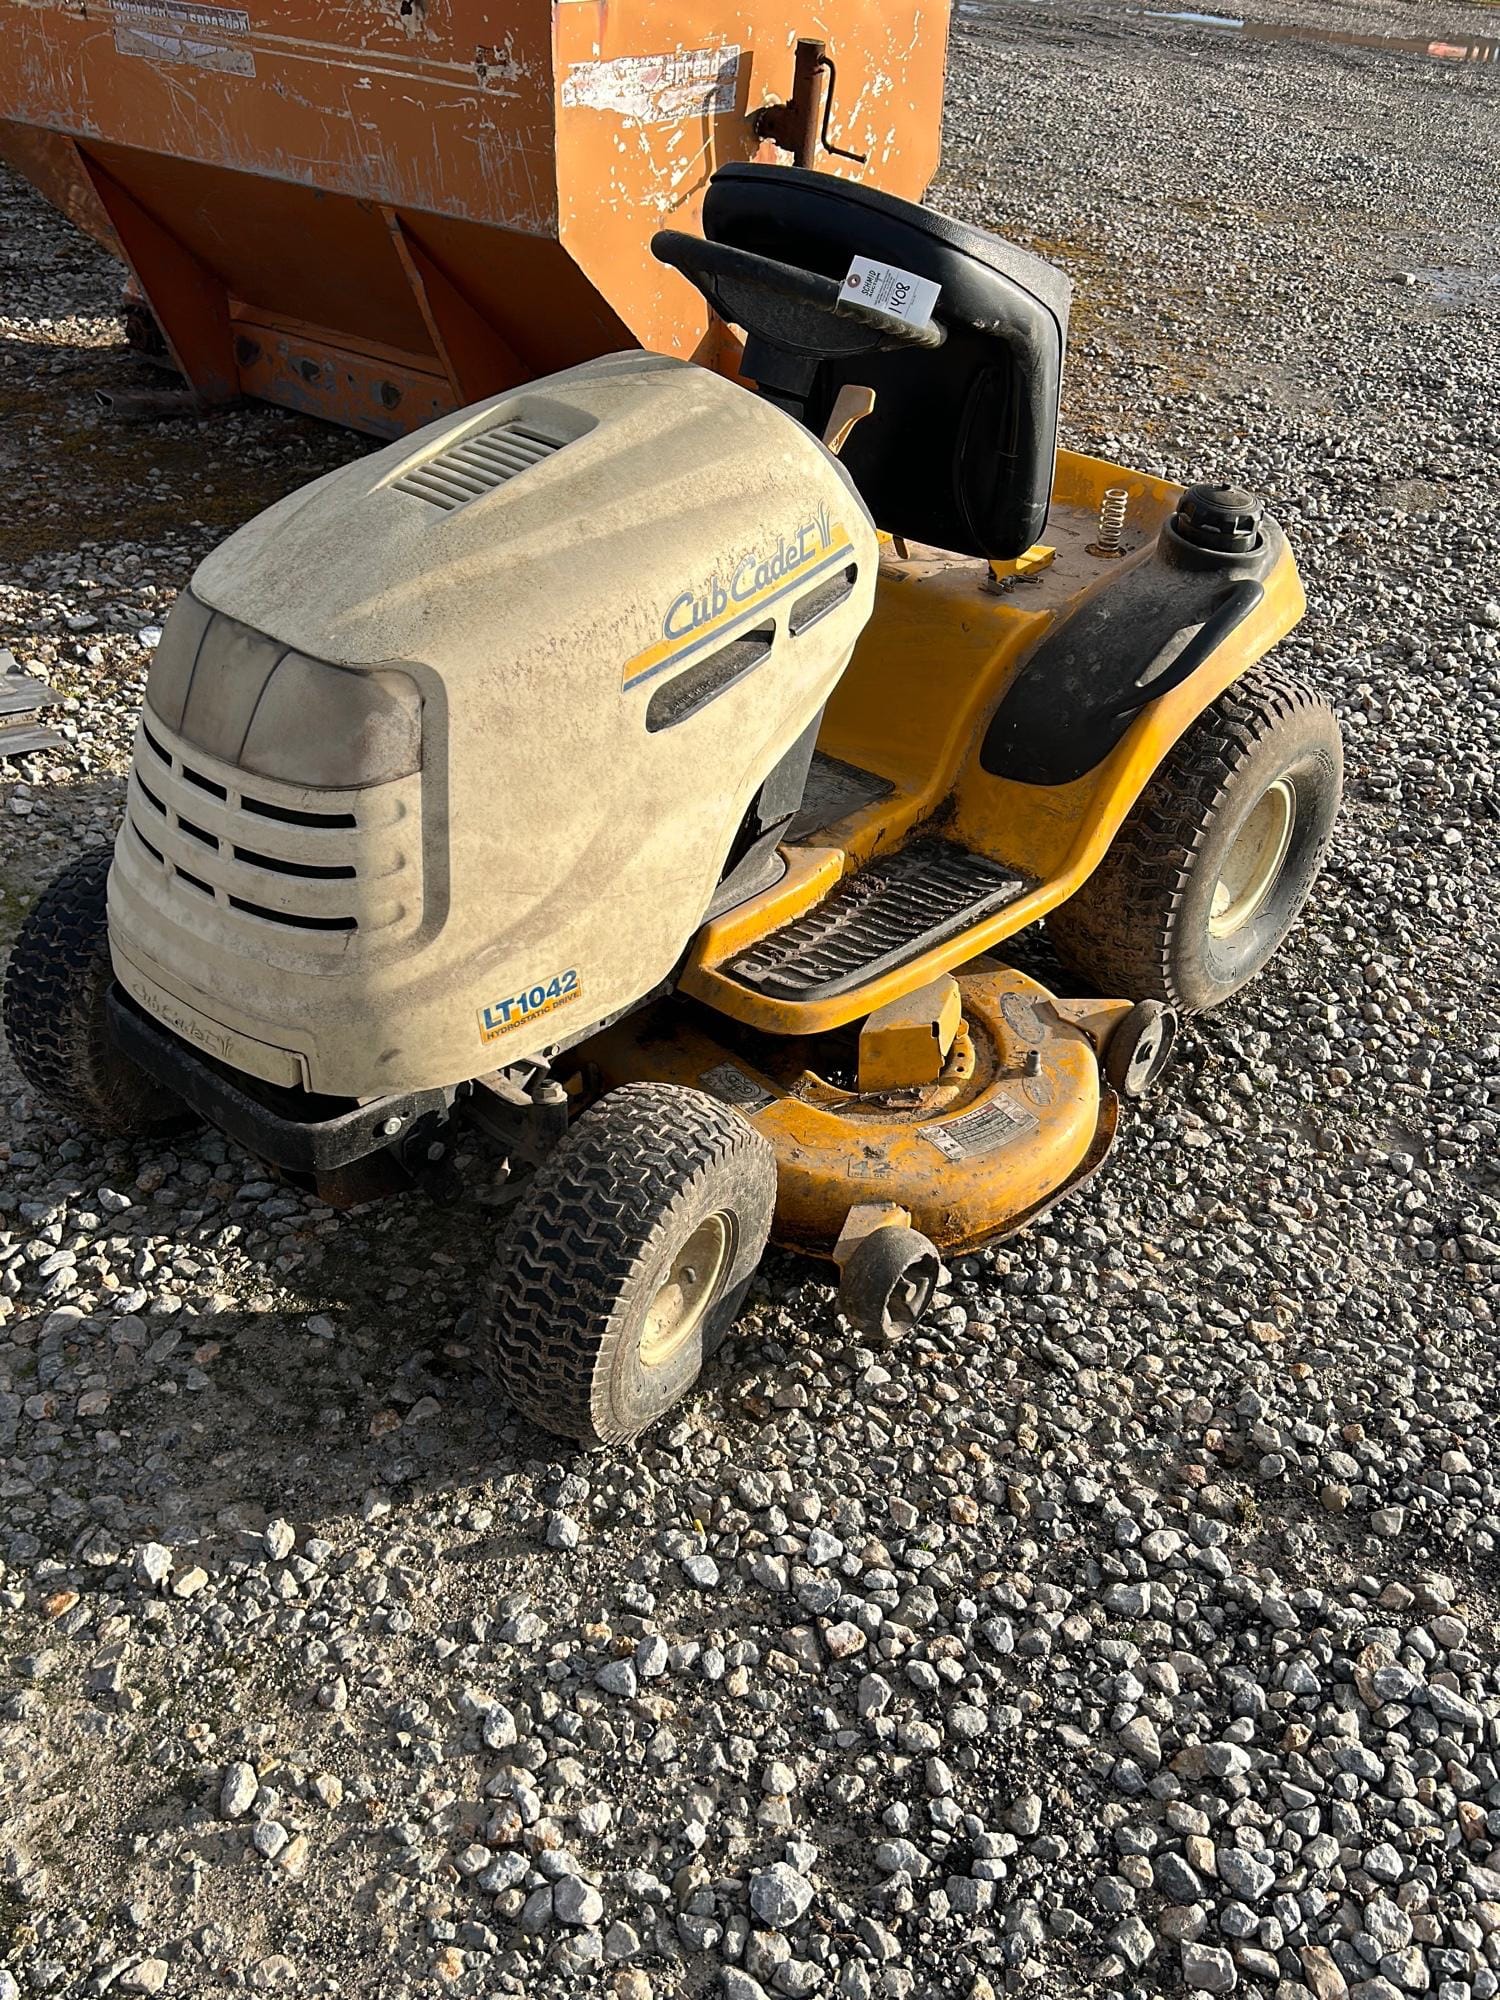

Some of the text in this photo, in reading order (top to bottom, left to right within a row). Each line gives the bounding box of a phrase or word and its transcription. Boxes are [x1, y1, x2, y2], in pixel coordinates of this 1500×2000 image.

[861, 269, 877, 296] SCHMID
[888, 281, 911, 314] 1408
[663, 523, 817, 641] Cub Cadet
[483, 969, 578, 1031] LT1042
[486, 991, 579, 1041] HYDROSTATIC DRIVE
